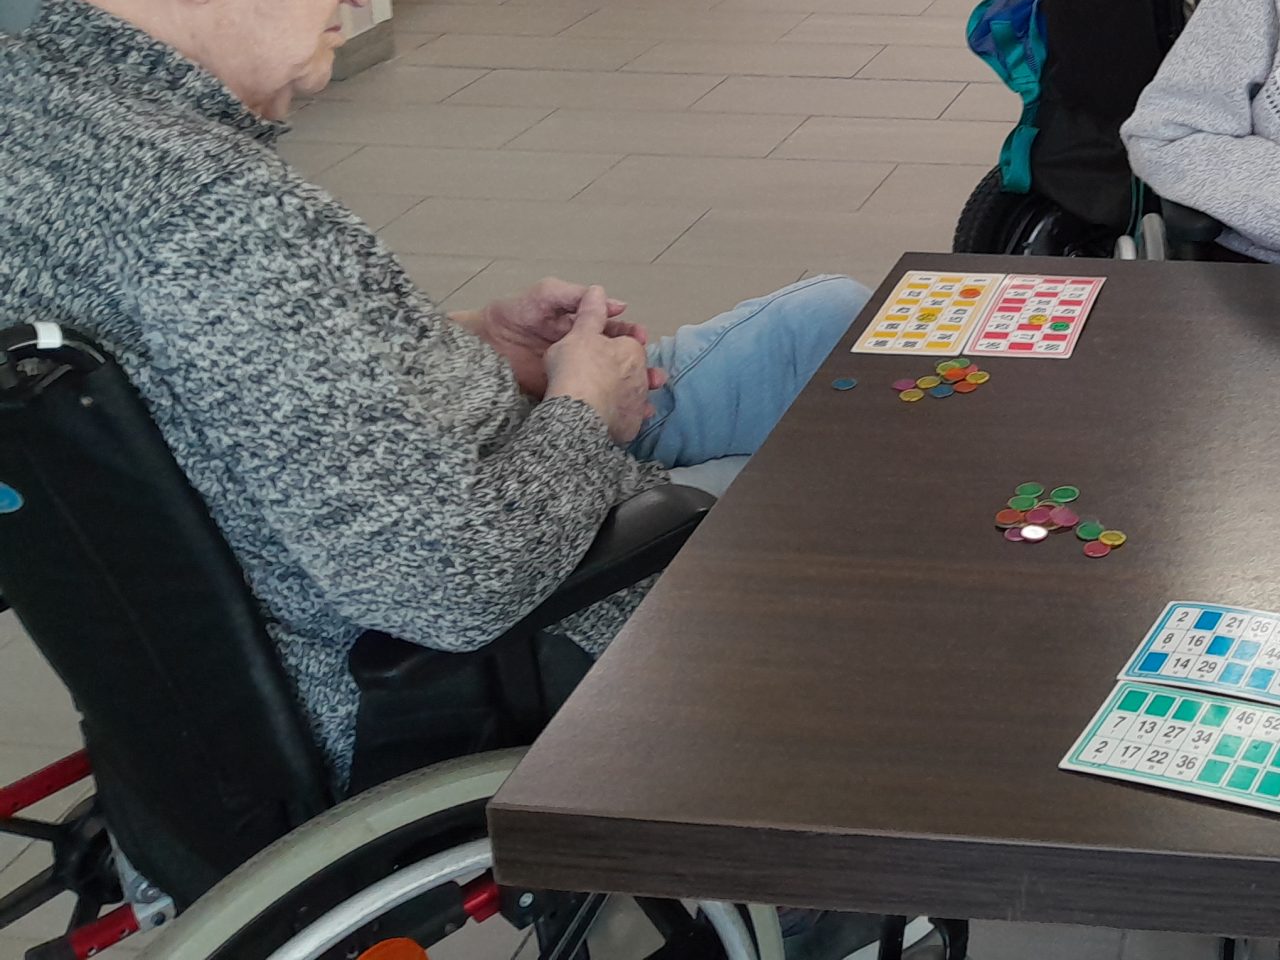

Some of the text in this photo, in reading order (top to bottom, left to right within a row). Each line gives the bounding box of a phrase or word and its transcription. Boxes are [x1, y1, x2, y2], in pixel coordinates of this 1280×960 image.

[1177, 612, 1188, 622] 2
[1226, 617, 1244, 628] 21
[1251, 621, 1270, 632] 36
[1163, 633, 1174, 644] 8
[1188, 635, 1205, 646] 16
[1174, 658, 1190, 669] 14
[1197, 661, 1217, 673] 29
[1236, 711, 1256, 724] 46
[1114, 716, 1126, 728] 7
[1139, 721, 1157, 733] 13
[1163, 726, 1185, 738] 27
[1192, 730, 1212, 744] 34
[1095, 741, 1108, 753] 2
[1122, 746, 1141, 758] 17
[1147, 750, 1168, 764] 22
[1176, 755, 1197, 769] 36
